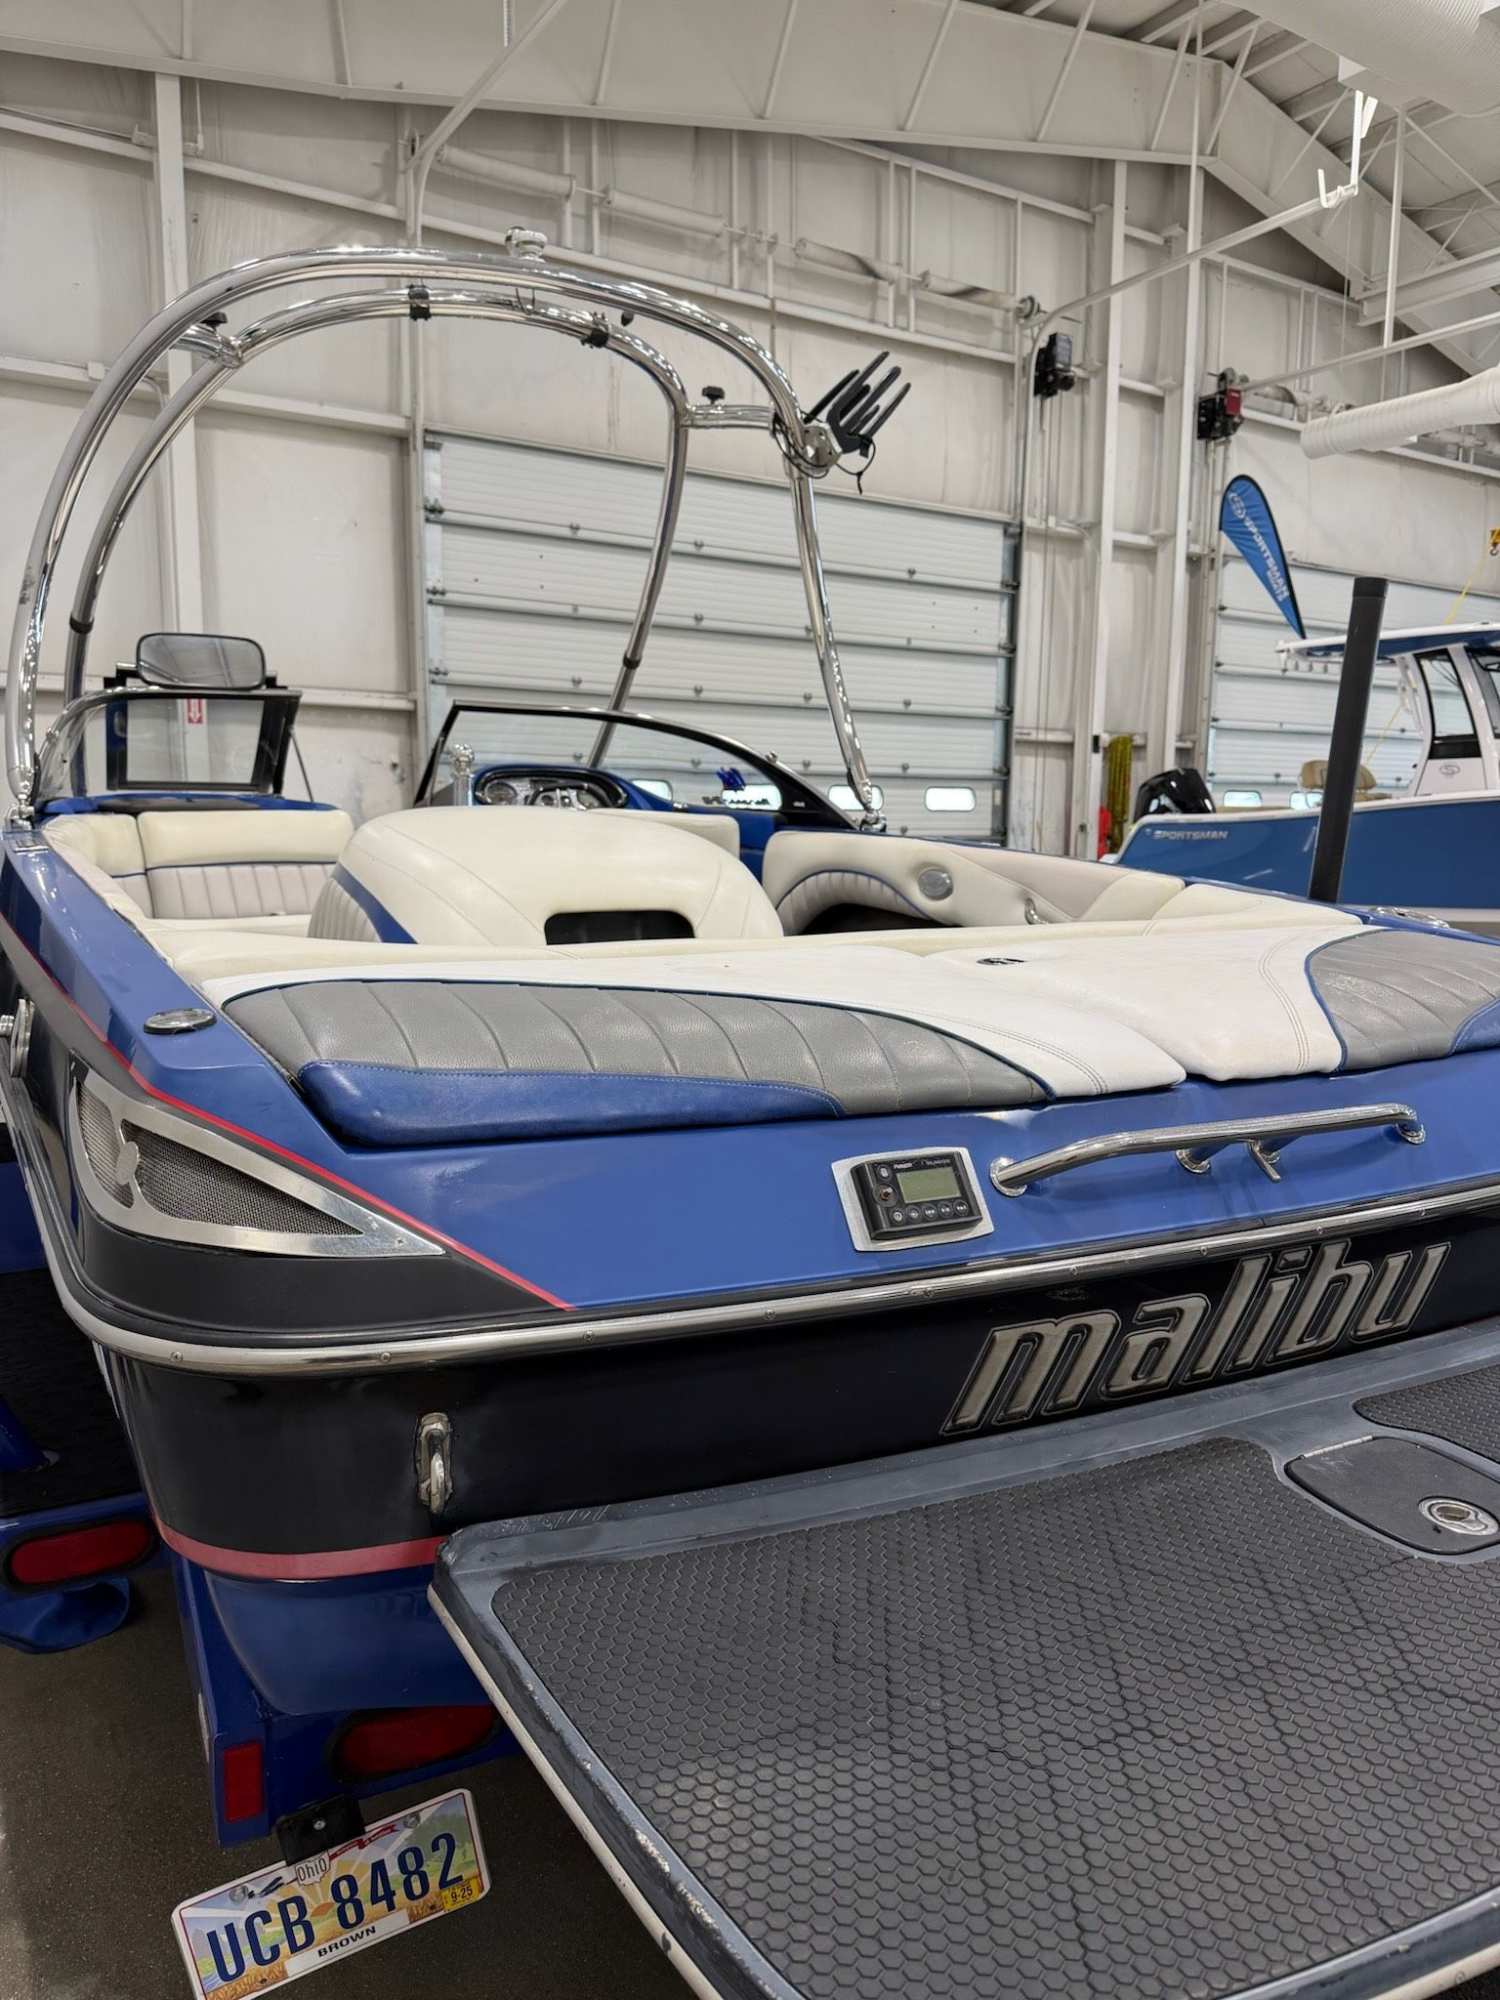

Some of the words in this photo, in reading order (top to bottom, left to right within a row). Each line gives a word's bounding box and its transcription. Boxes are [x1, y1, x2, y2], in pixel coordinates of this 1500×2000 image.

[1245, 517, 1289, 598] SPORTSMAN
[1154, 830, 1228, 840] SPORTSMAN
[939, 1238, 1452, 1436] malibu
[206, 1895, 315, 1983] UCB
[330, 1832, 464, 1931] 8482
[450, 1885, 473, 1902] 9-25
[317, 1926, 376, 1957] BROWN
